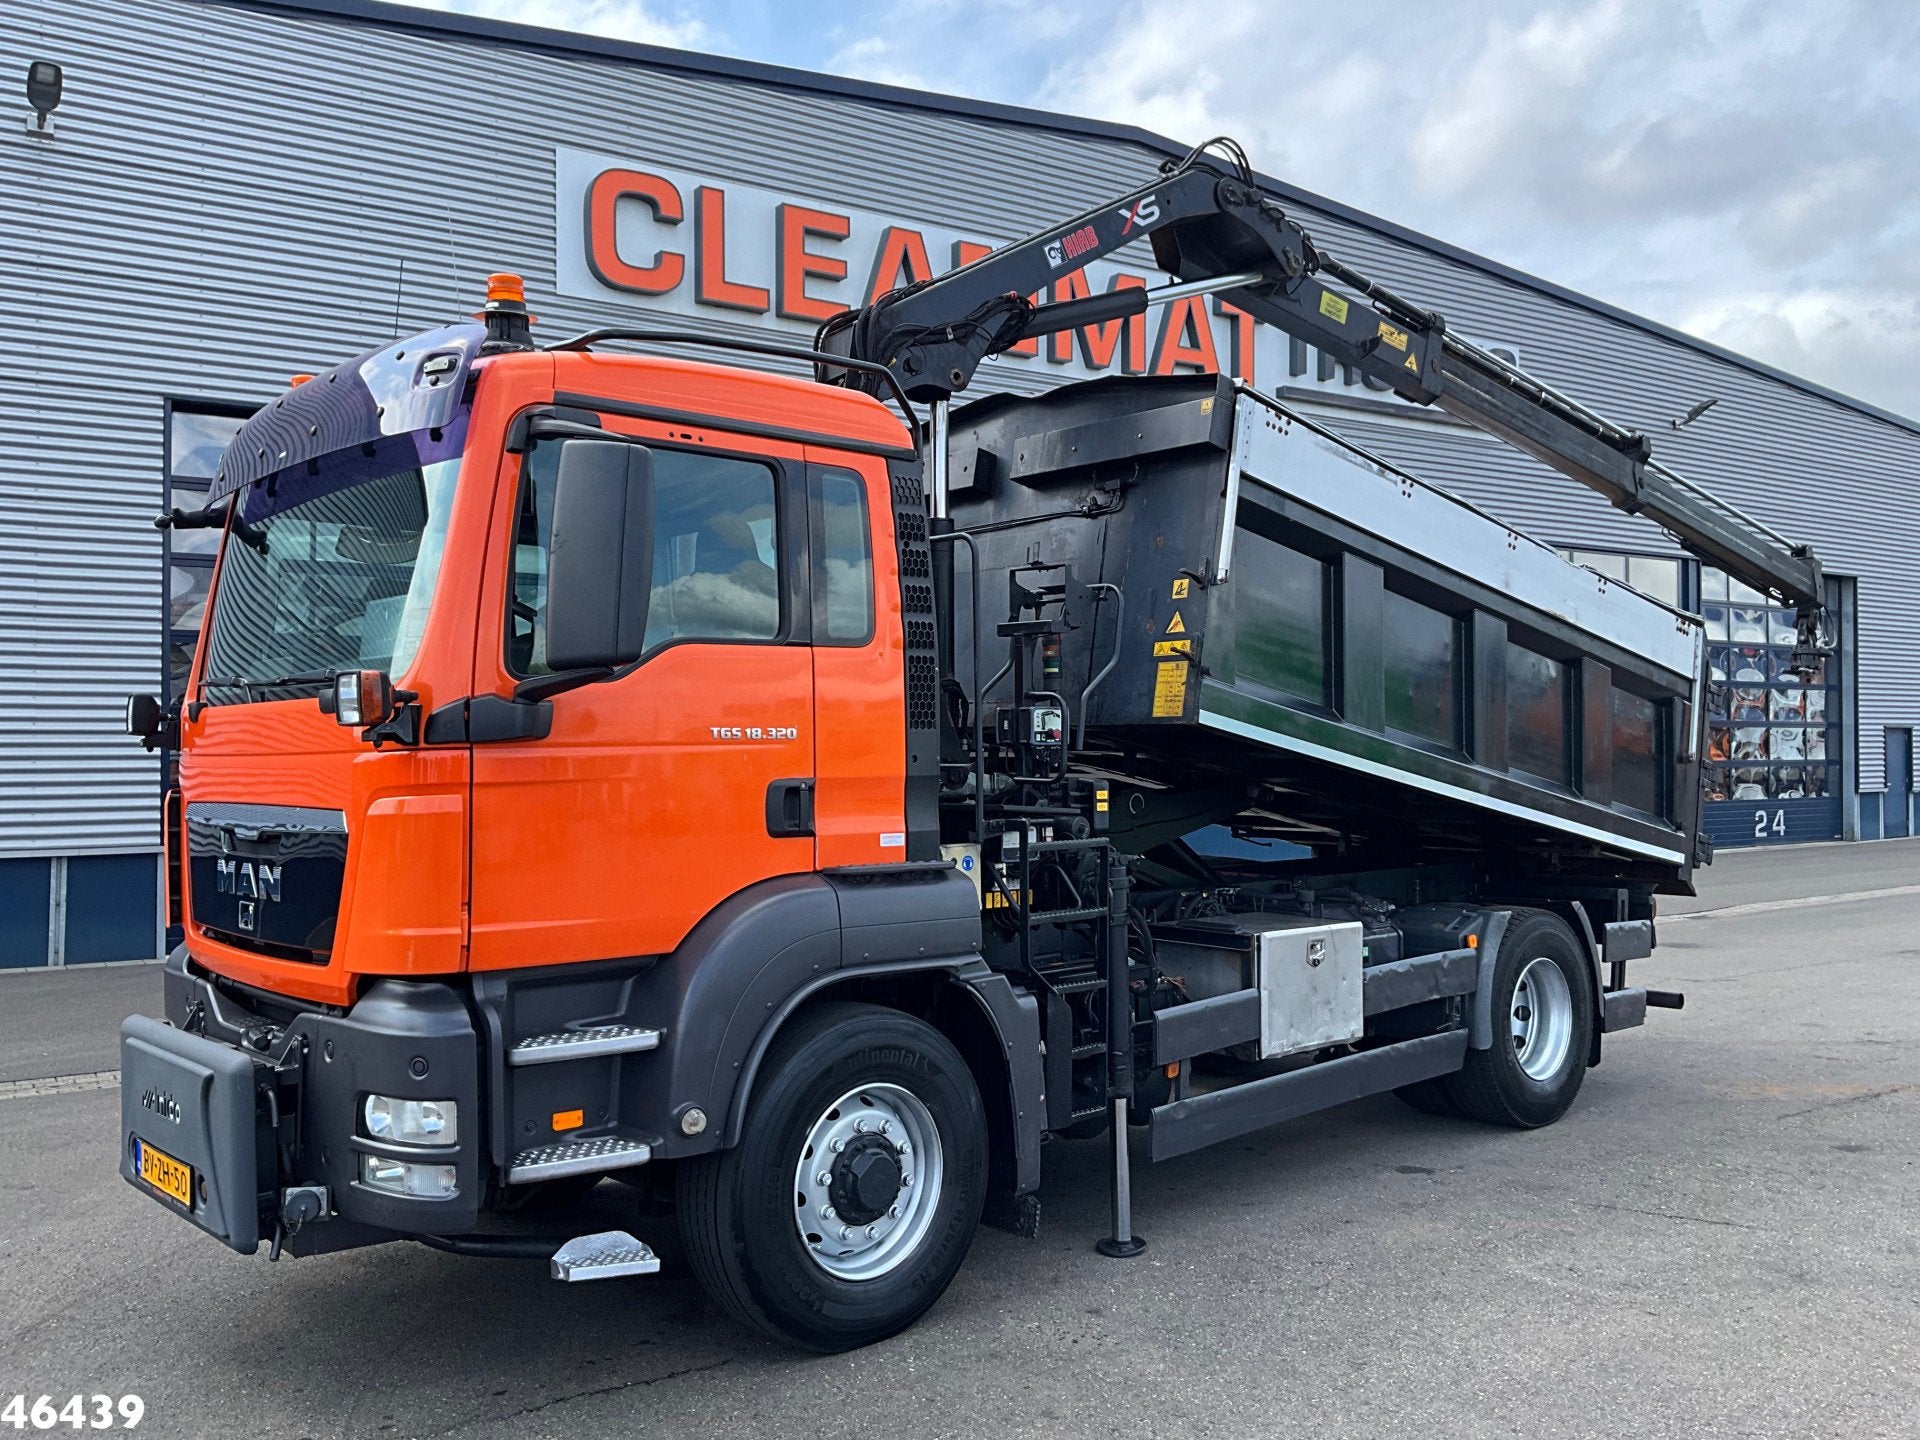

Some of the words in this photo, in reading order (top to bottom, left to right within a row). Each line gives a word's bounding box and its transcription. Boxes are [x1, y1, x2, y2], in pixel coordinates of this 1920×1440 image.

[1062, 226, 1098, 259] HIAB
[1118, 194, 1160, 235] XS
[585, 168, 1264, 388] CLEAMAT
[710, 727, 741, 740] TGS
[745, 727, 797, 740] 18.320
[1755, 809, 1786, 837] 24
[217, 859, 282, 902] MAN
